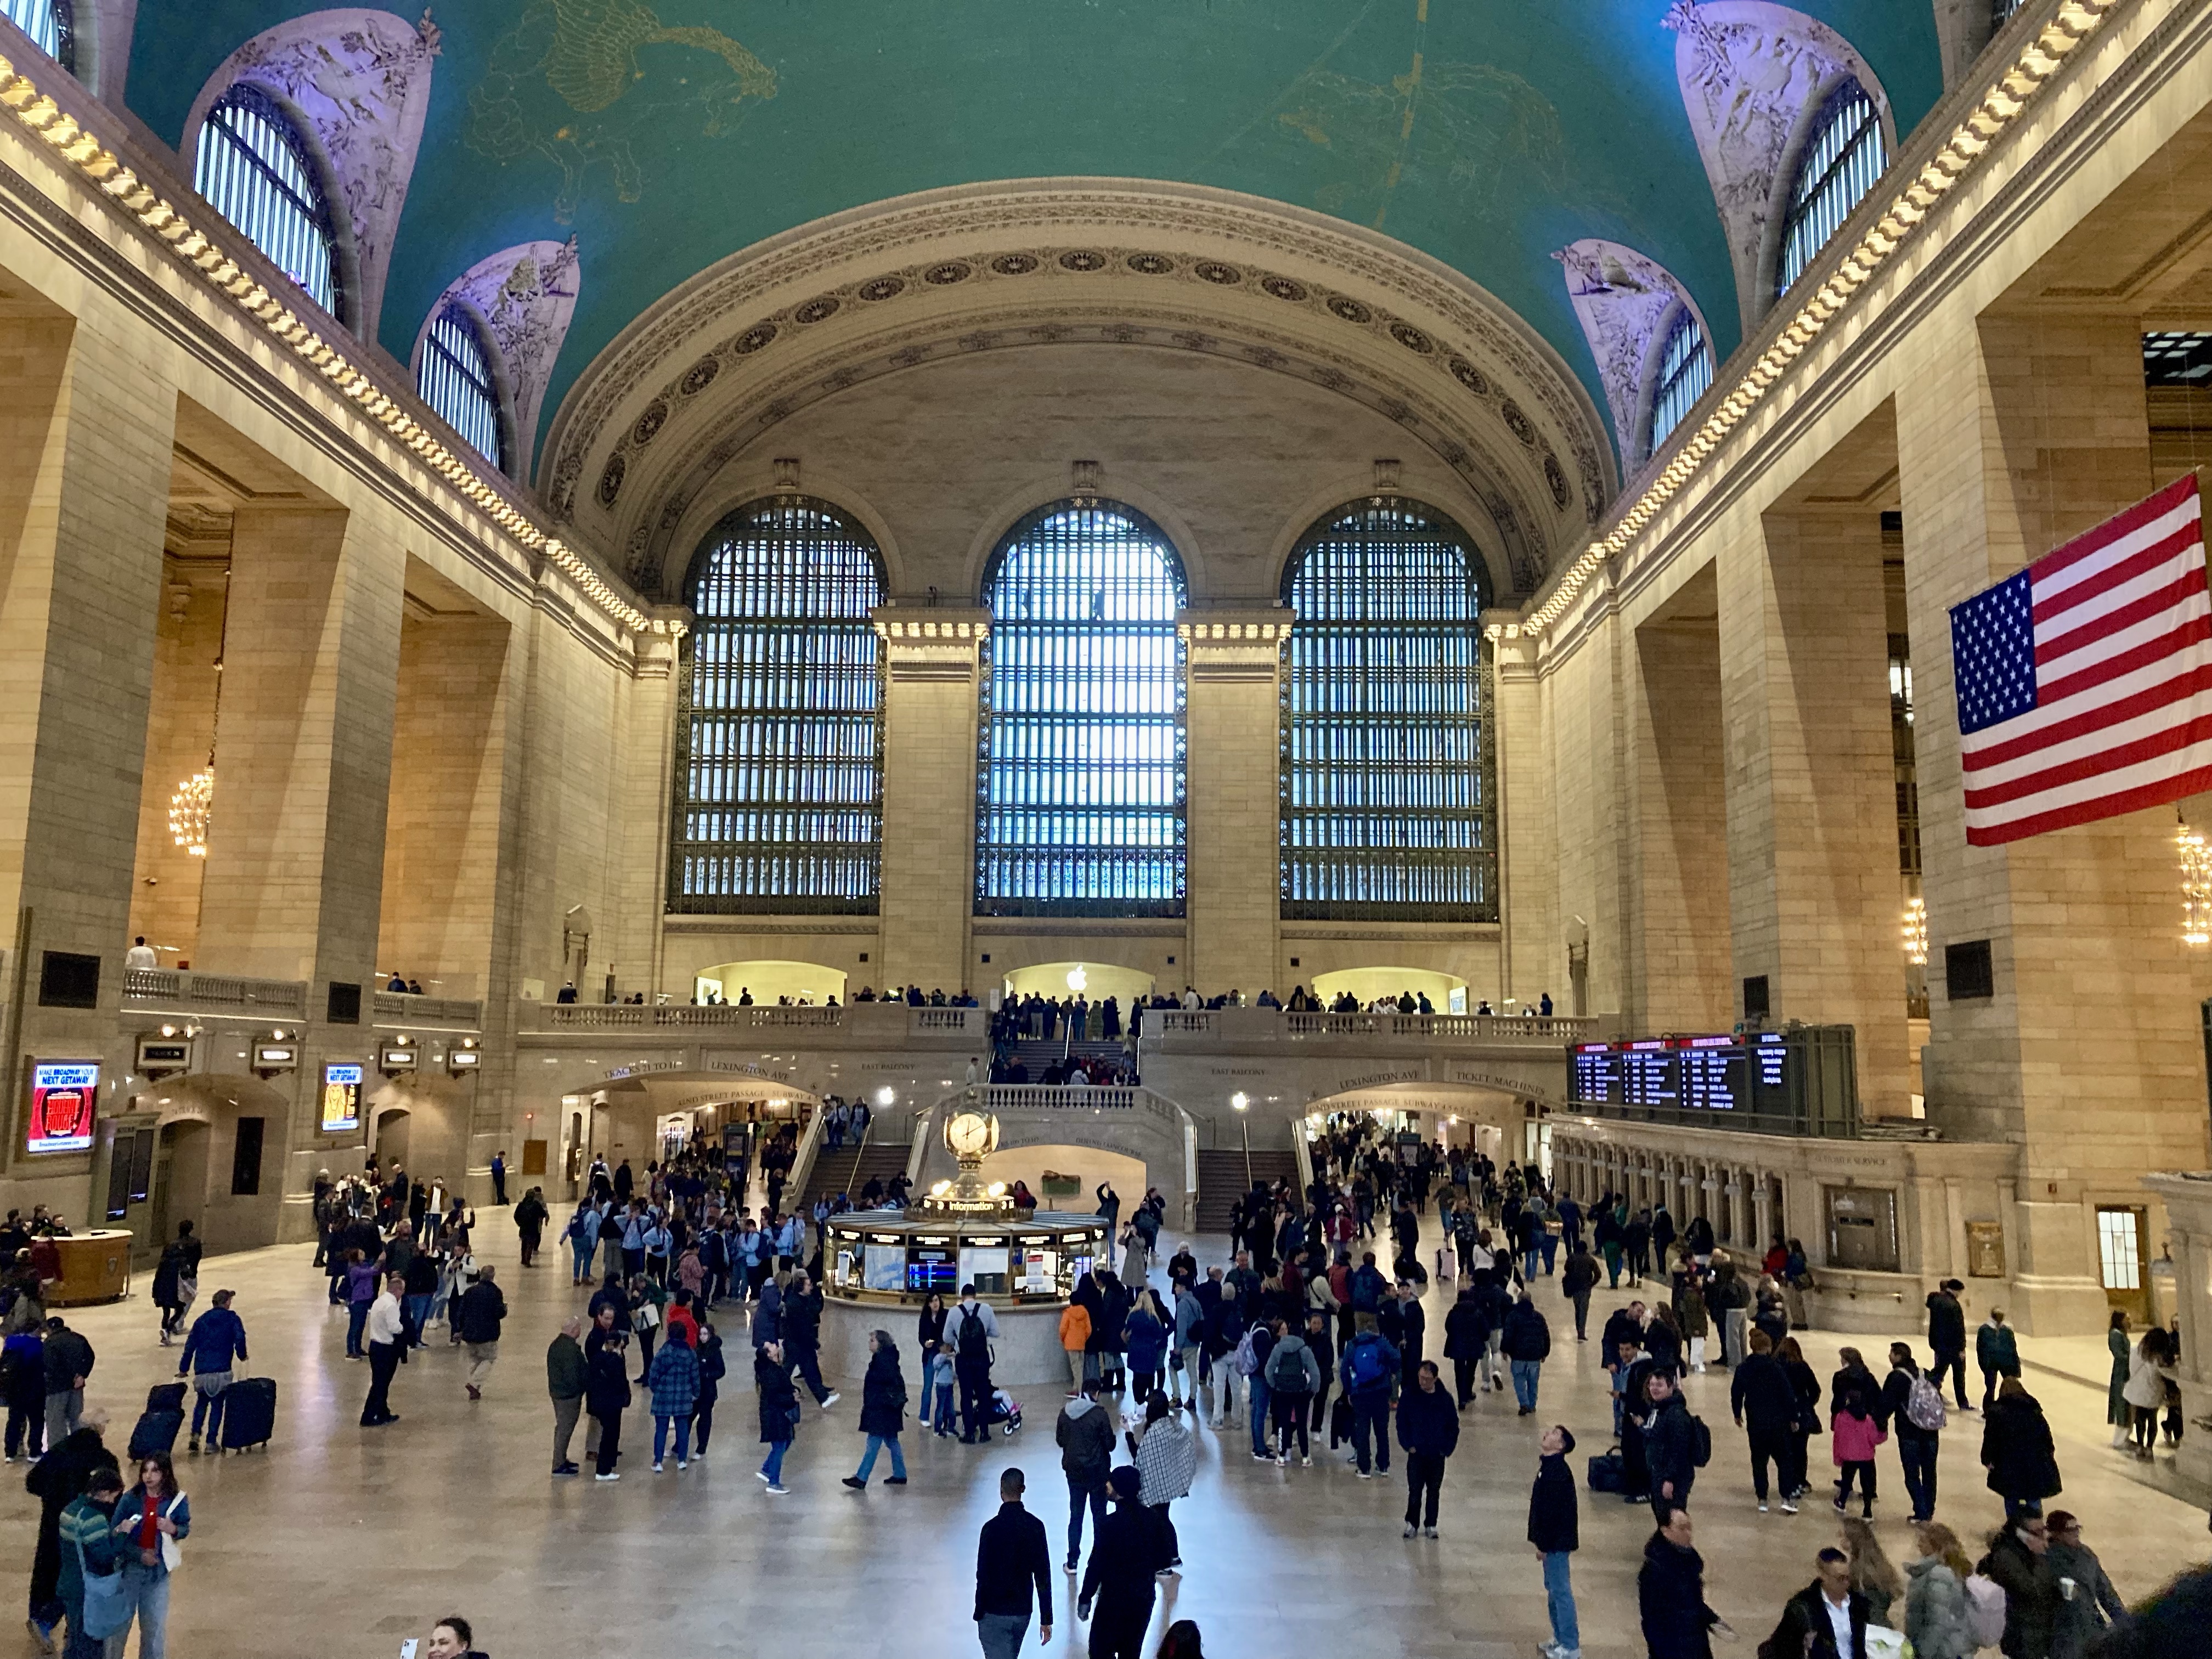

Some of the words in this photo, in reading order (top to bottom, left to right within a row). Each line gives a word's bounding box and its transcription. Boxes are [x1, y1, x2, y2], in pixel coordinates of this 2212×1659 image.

[603, 1065, 640, 1078] TRACKS
[654, 1062, 667, 1070] TO
[711, 1062, 768, 1076] LEXINGTON
[771, 1070, 790, 1081] AVE
[42, 1076, 59, 1085] NEXT
[61, 1076, 89, 1085] GETAWAY
[1340, 1072, 1398, 1089] LEXINGTON
[1401, 1070, 1419, 1079] AVE
[1456, 1071, 1489, 1082] TICKET
[1494, 1076, 1545, 1096] MACHINES
[731, 1090, 765, 1098] PASSAGE
[772, 1091, 805, 1099] SUBWAY
[1331, 1100, 1361, 1109] STREET
[1404, 1099, 1440, 1109] SUBWAY
[949, 1201, 994, 1211] Information
